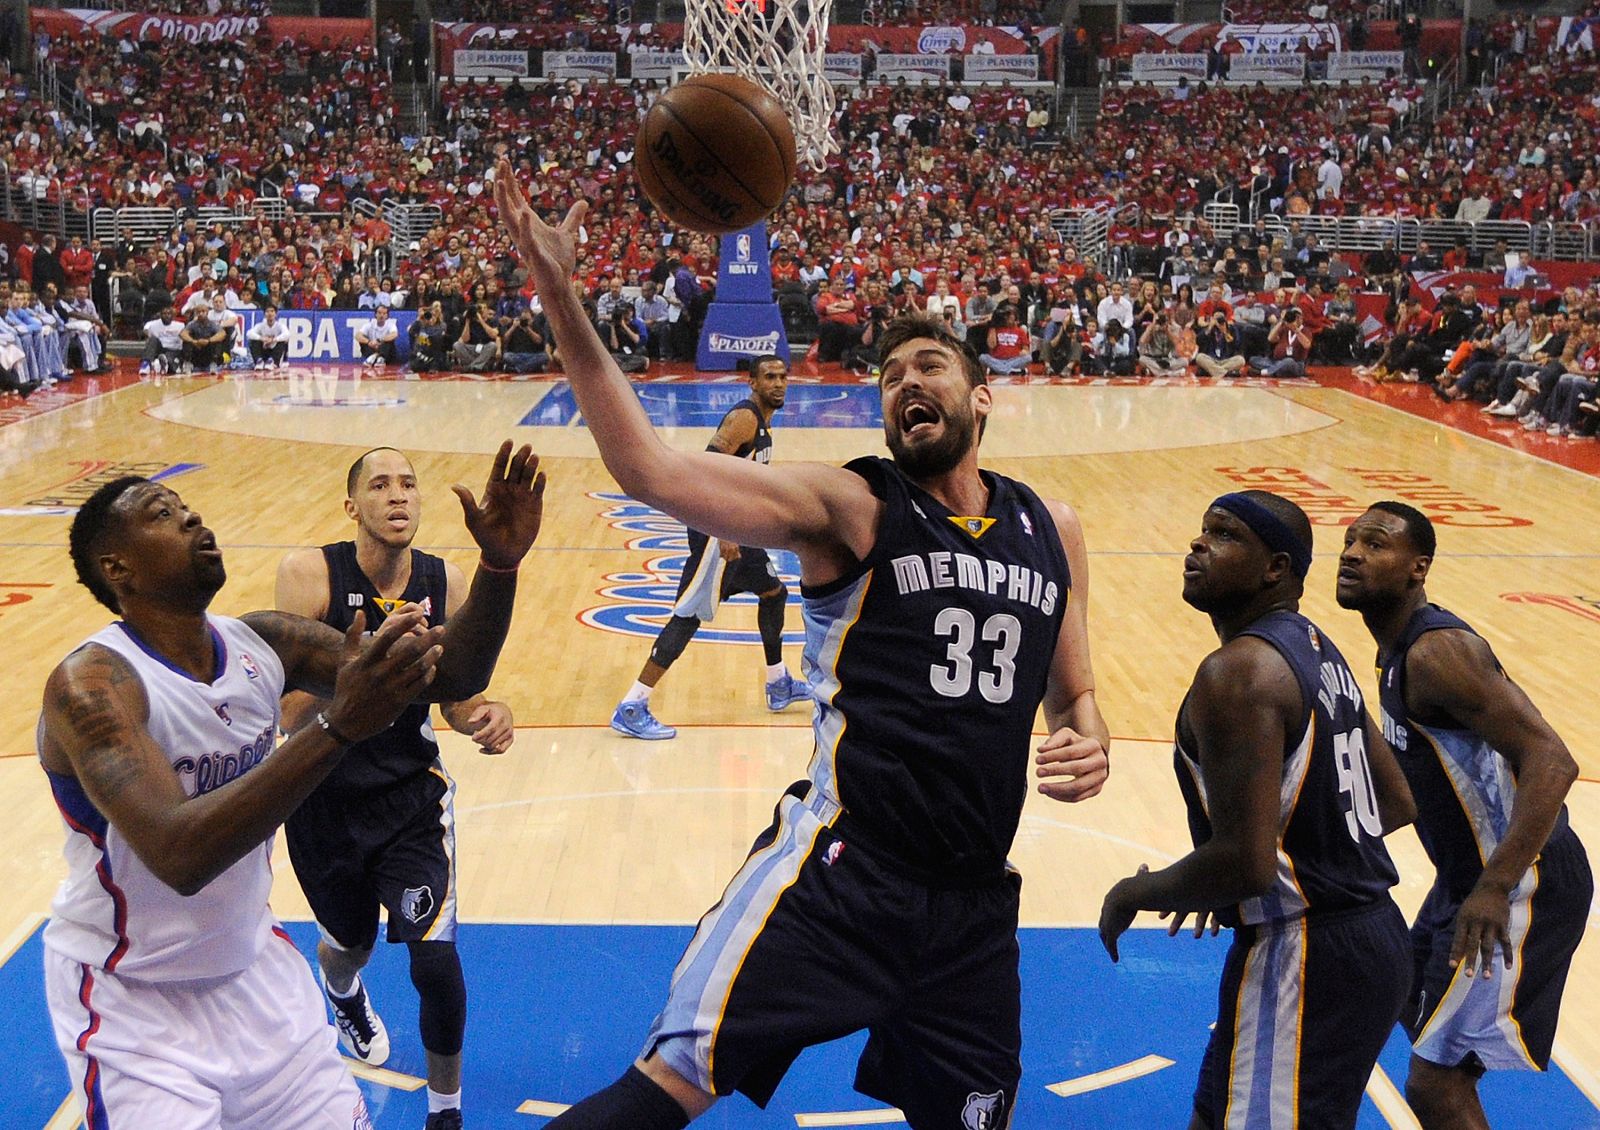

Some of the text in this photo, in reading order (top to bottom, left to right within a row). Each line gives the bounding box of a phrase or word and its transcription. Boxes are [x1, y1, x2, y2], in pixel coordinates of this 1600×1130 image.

[476, 54, 525, 63] PLAYOFFS
[566, 55, 613, 64] PLAYOFFS
[824, 57, 859, 66] AYOFFS
[900, 57, 947, 67] PLAYOFFS
[987, 58, 1036, 67] PLAYOFFS
[1155, 57, 1204, 67] PLAYOFFS
[1254, 57, 1301, 66] PLAYOFFS
[1350, 55, 1401, 65] PLAYOFFS
[728, 264, 759, 275] NBA TV
[281, 317, 340, 359] BA
[718, 337, 777, 351] PLAYOFFS
[890, 551, 1058, 616] MEMPHIS
[347, 592, 364, 607] DD
[929, 607, 1022, 704] 33
